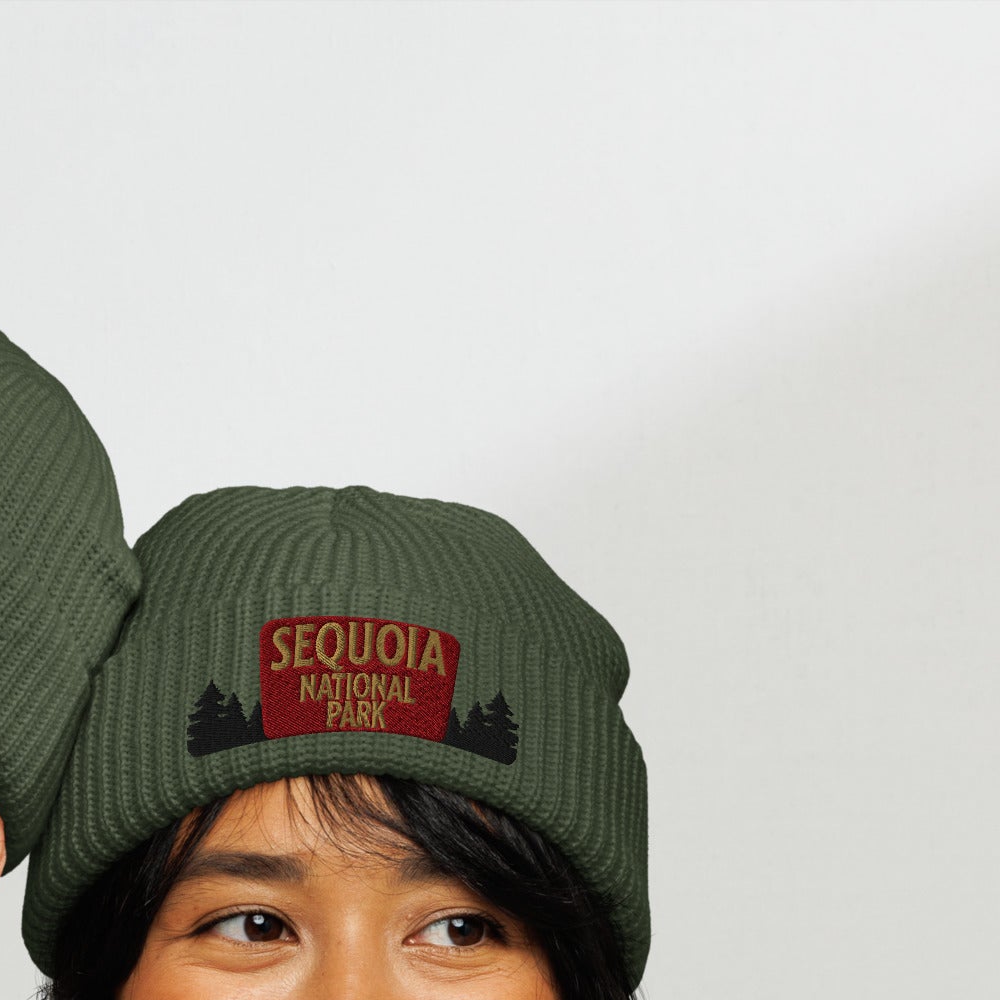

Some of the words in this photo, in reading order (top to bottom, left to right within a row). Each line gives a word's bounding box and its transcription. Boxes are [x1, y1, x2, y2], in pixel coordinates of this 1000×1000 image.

[270, 621, 446, 677] SEQUOIA
[300, 672, 415, 704] NATIONAL
[325, 700, 387, 729] PARK
